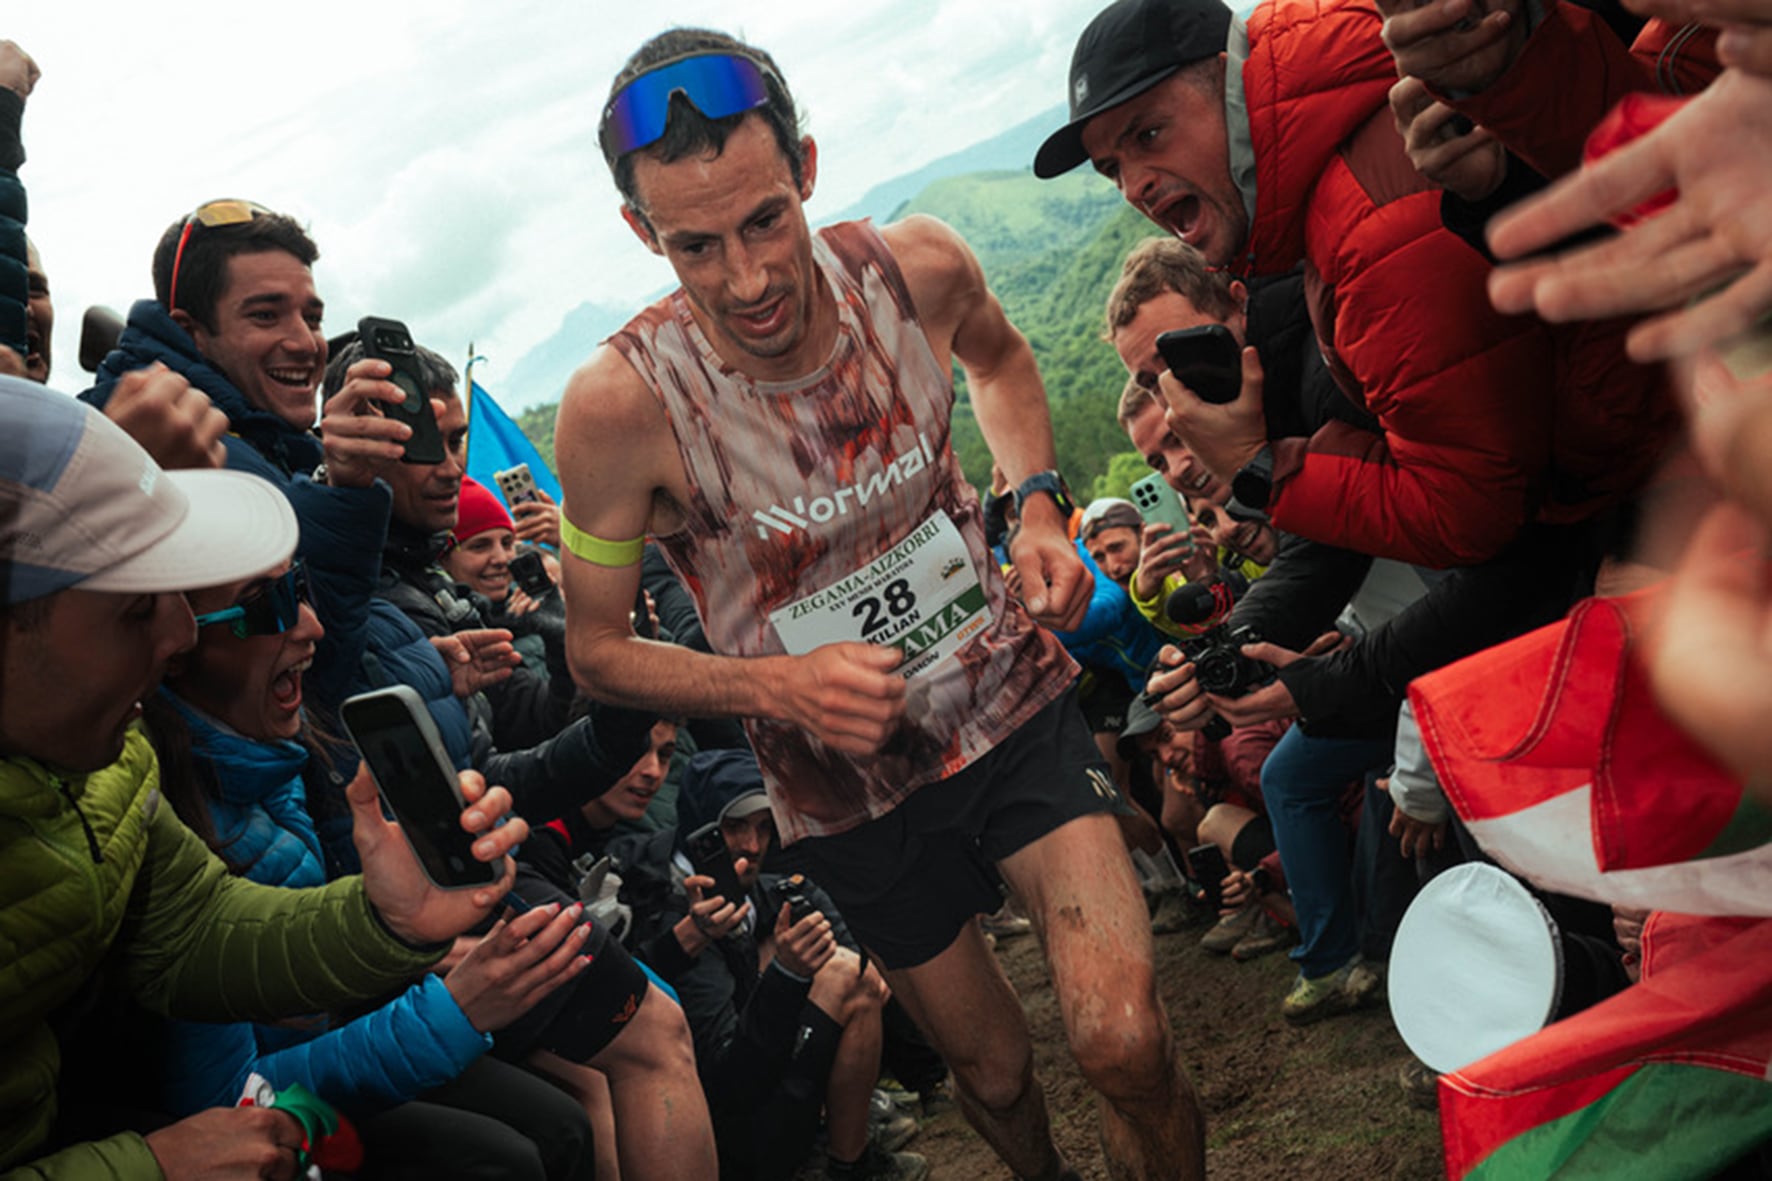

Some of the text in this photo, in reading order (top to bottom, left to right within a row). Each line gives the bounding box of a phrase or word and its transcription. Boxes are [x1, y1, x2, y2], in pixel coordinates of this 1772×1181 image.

[788, 519, 941, 620] ZEGAMA-AIZKORRI
[852, 578, 917, 637] 28
[867, 609, 921, 646] KILIAN
